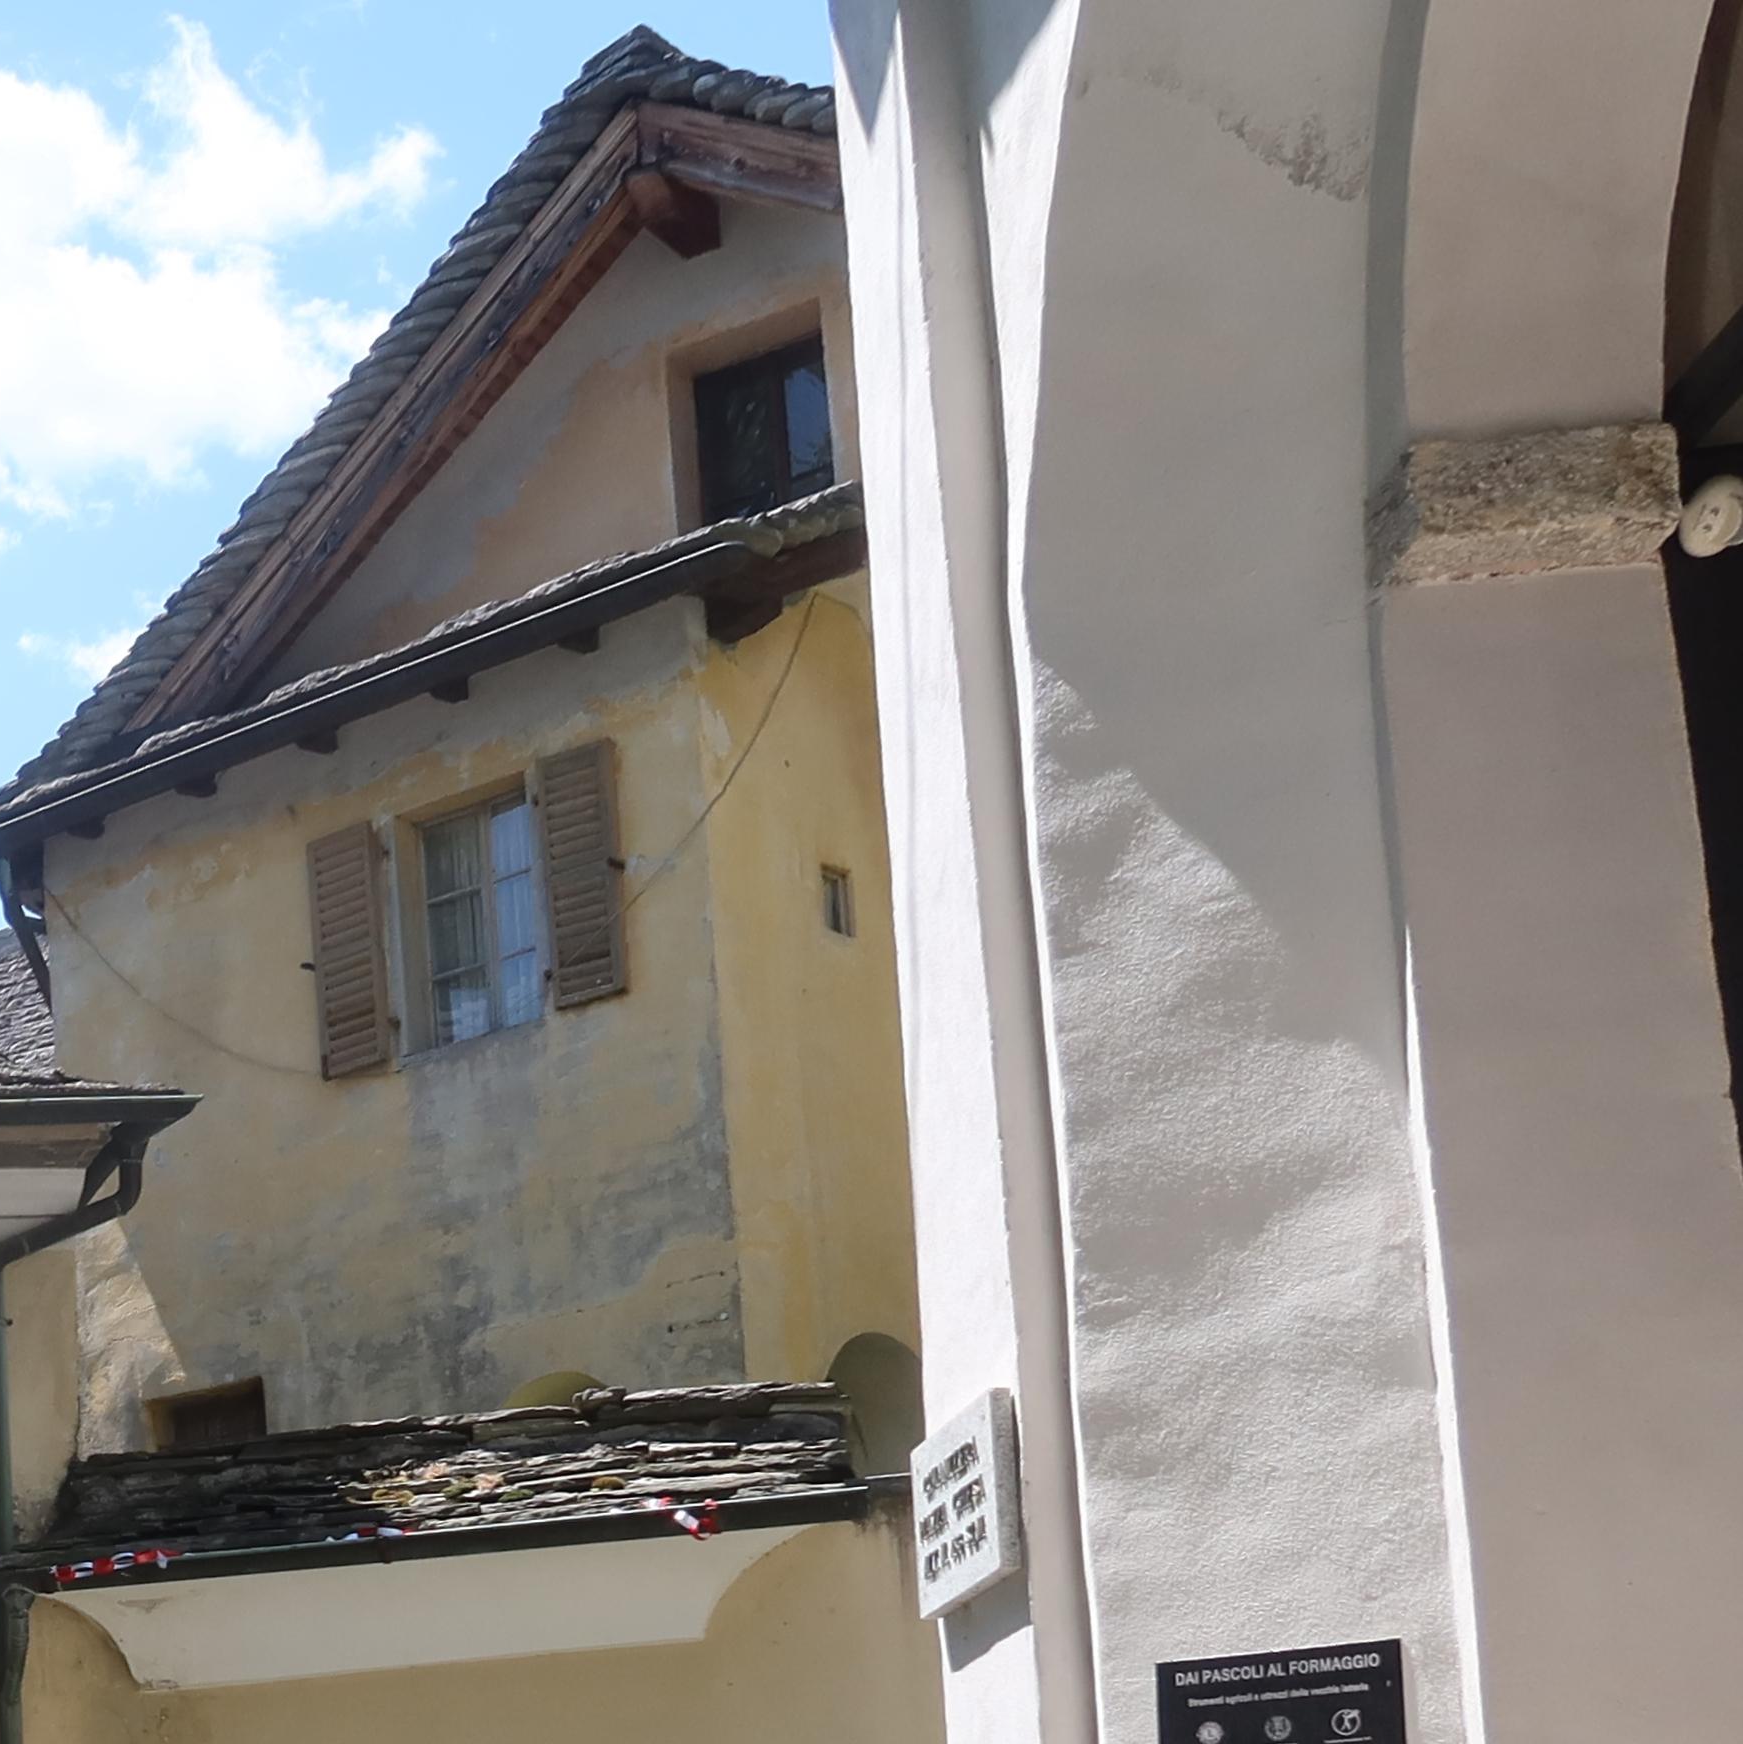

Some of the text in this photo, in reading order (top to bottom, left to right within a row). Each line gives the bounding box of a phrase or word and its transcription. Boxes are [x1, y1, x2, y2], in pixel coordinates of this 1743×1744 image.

[1175, 1653, 1381, 1687] DAI PASCOLI AL FORMAGGIO
